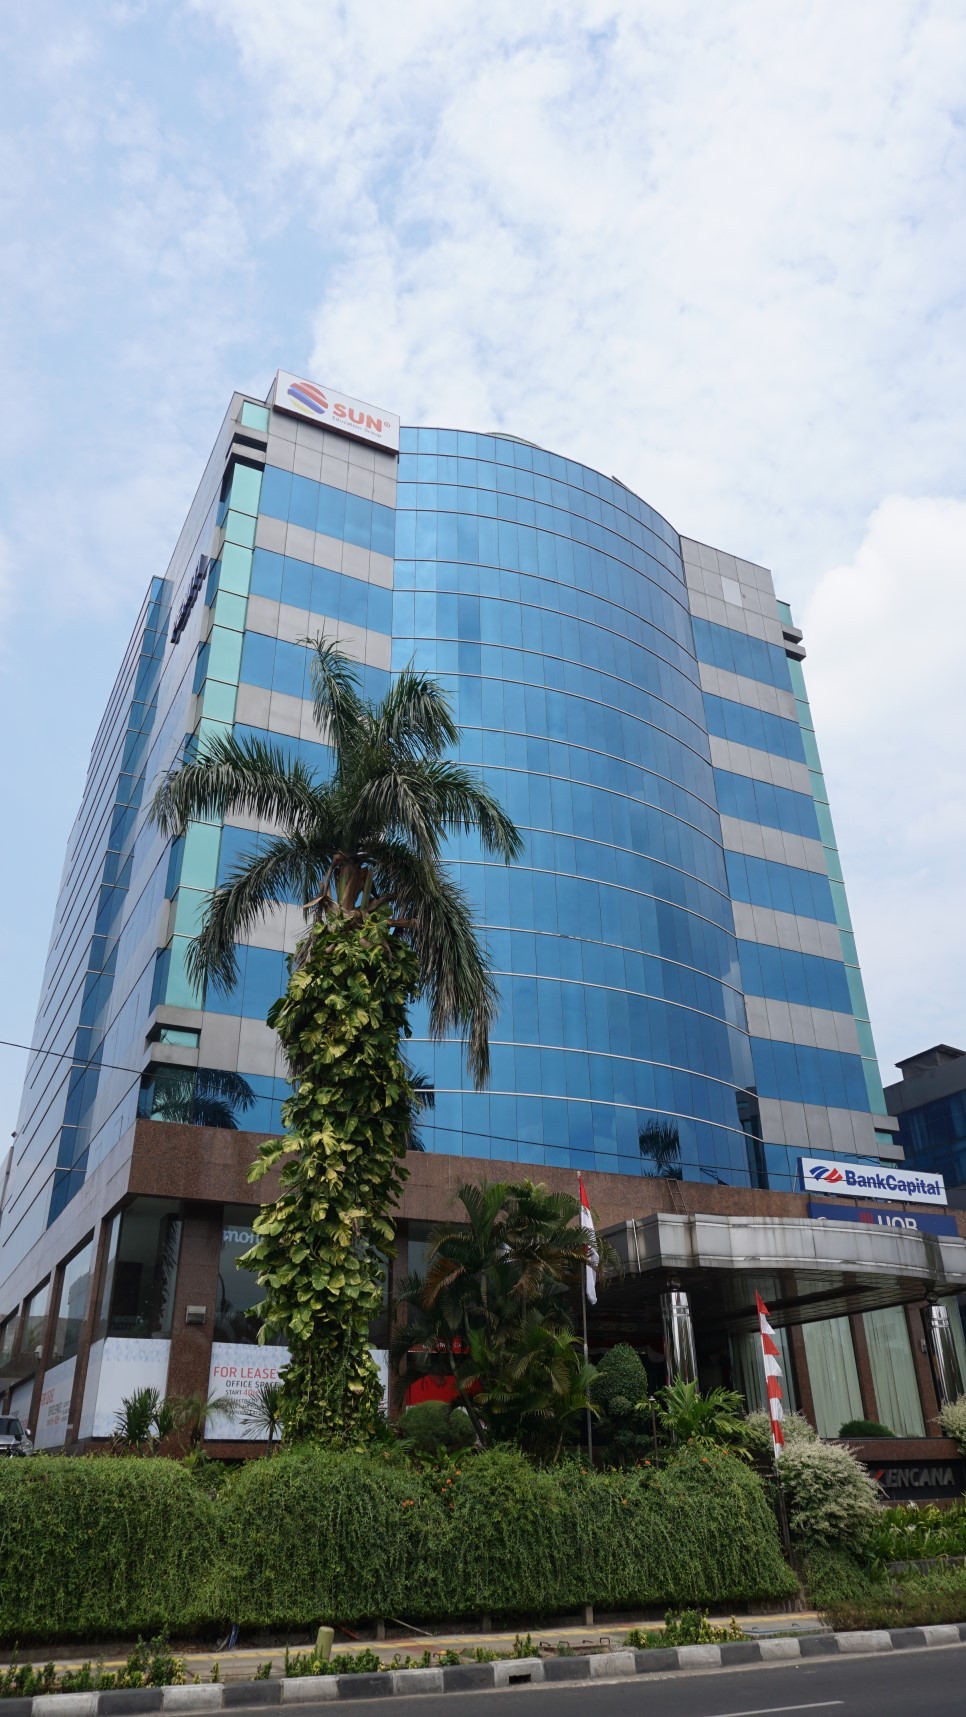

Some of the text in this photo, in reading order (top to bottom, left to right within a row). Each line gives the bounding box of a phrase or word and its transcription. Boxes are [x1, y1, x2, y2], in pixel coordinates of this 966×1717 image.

[332, 403, 383, 432] SUN
[844, 1169, 941, 1196] BankCapital
[213, 1366, 277, 1379] FOR LEASE
[225, 1380, 253, 1388] OFFICE
